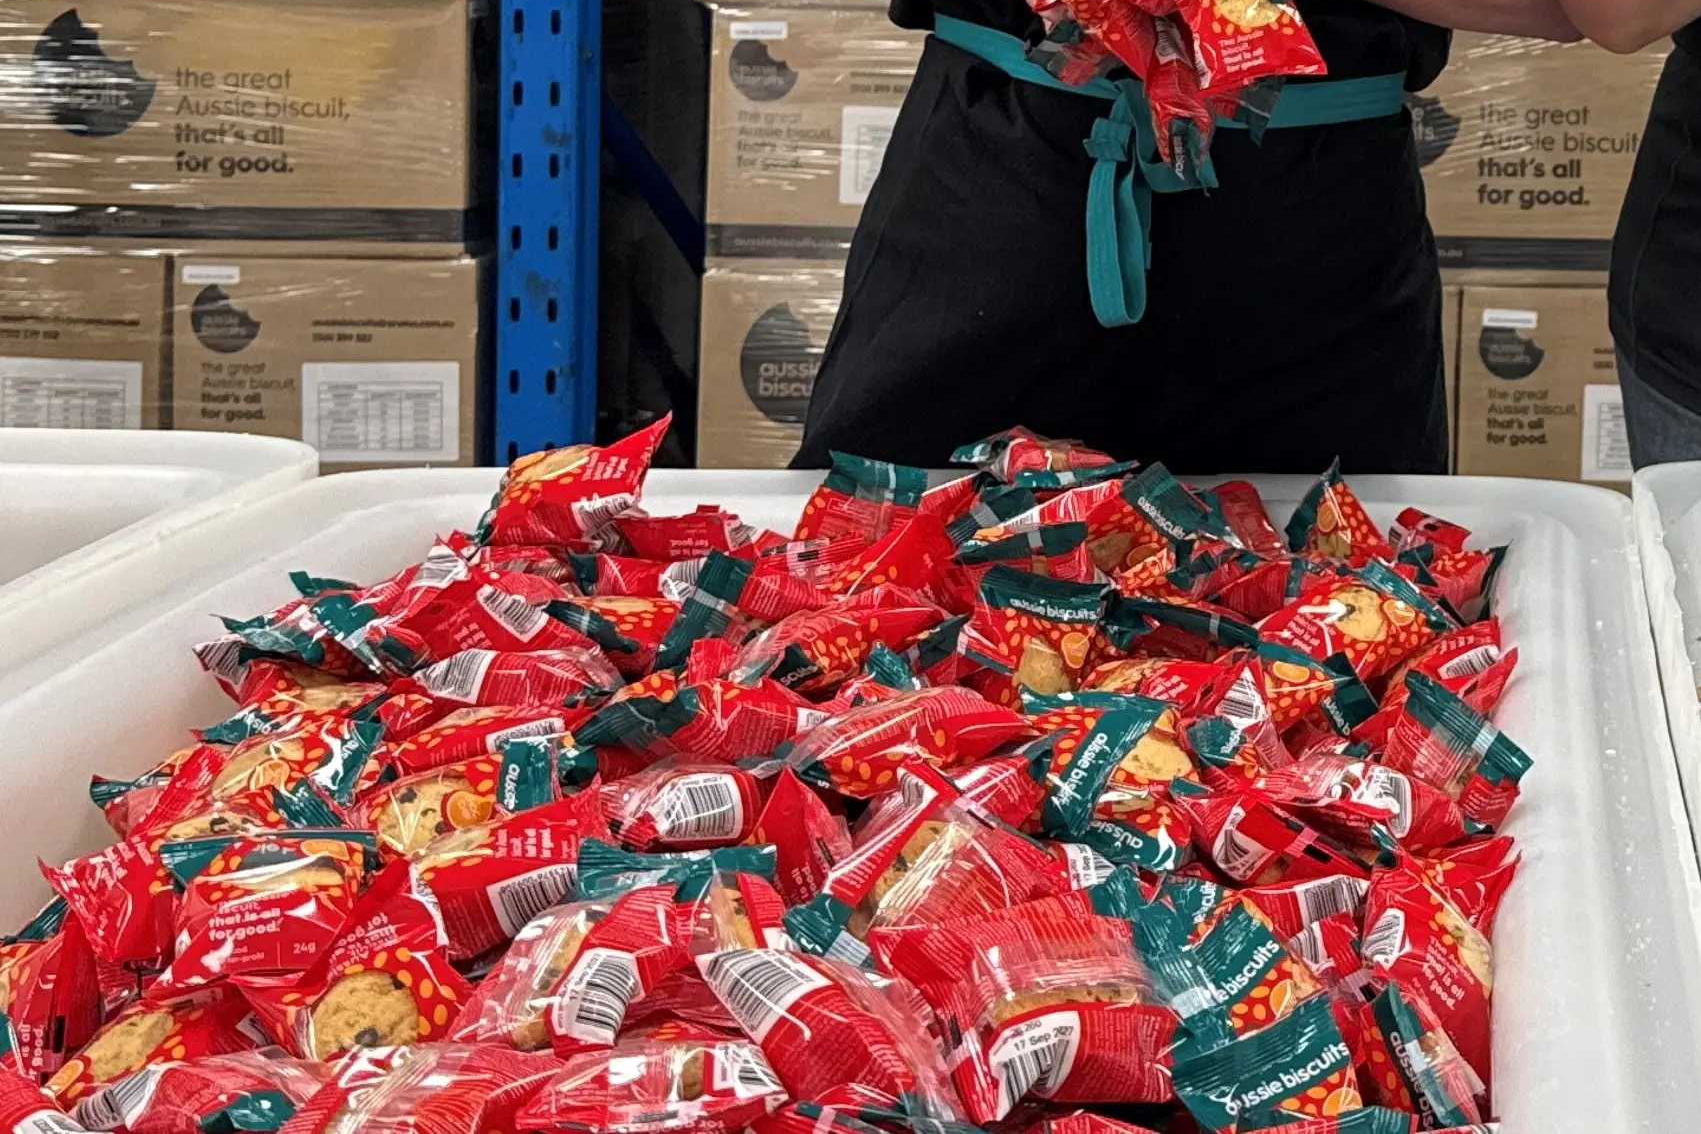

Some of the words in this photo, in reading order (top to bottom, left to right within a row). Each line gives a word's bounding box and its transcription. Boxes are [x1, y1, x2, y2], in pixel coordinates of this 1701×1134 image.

[176, 68, 215, 88] the
[223, 68, 292, 94] great
[176, 95, 256, 116] Aussie
[265, 96, 350, 121] biscuit,
[1480, 104, 1518, 124] the
[1525, 106, 1590, 130] great
[175, 122, 246, 144] that's
[253, 126, 284, 145] all
[1479, 132, 1555, 152] Aussie
[176, 150, 213, 172] for
[219, 152, 294, 178] good.
[1478, 158, 1546, 178] that's
[1553, 159, 1581, 179] all
[1478, 185, 1512, 204] for
[1519, 186, 1590, 209] good.
[202, 362, 221, 373] the
[228, 363, 266, 376] great
[202, 377, 247, 389] Aussie
[201, 392, 240, 404] that's
[244, 393, 262, 404] all
[1488, 388, 1508, 400] the
[1512, 389, 1549, 403] great
[201, 408, 221, 419] for
[226, 409, 265, 422] good.
[1488, 403, 1530, 416] Aussie
[1487, 418, 1524, 430] that's
[1528, 418, 1544, 430] all
[1486, 432, 1507, 444] for
[1510, 433, 1548, 446] good.
[1010, 598, 1046, 615] aussie
[1078, 733, 1108, 768] aussie
[209, 913, 242, 928] that
[209, 928, 233, 941] for
[293, 942, 316, 956] 24g
[1221, 939, 1280, 996] biscuits
[1029, 1033, 1051, 1046] Sep
[1278, 1041, 1350, 1090] biscuits
